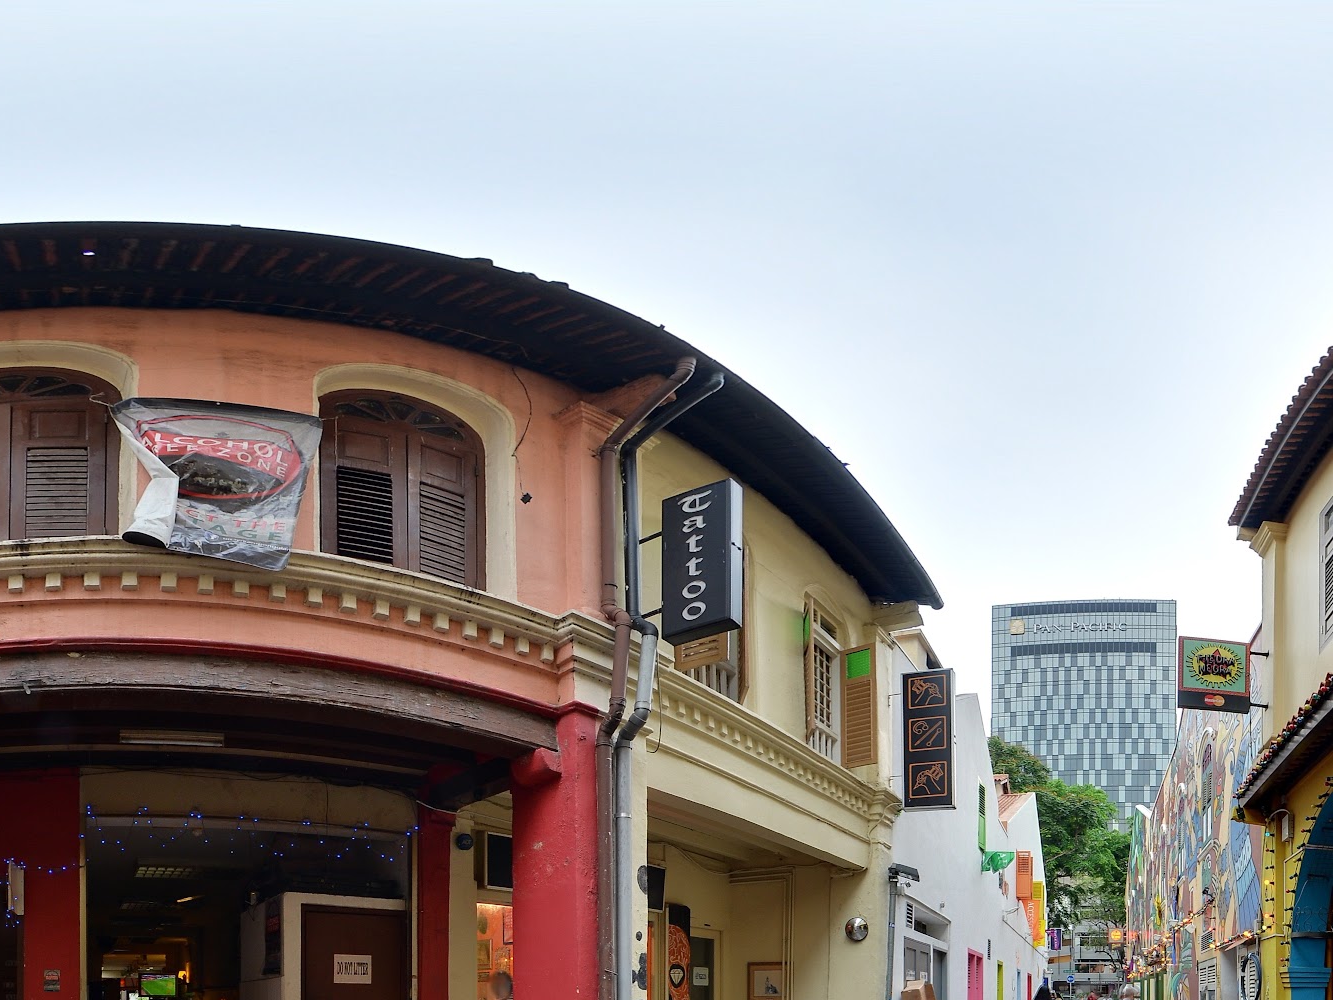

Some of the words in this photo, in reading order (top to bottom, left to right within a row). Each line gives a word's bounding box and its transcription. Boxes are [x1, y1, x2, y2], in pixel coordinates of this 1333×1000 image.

[217, 448, 287, 479] ZONE
[235, 518, 286, 532] THE
[677, 489, 712, 621] Tattoo
[1033, 624, 1063, 634] PAN
[1070, 622, 1128, 633] PACIFIC
[1196, 654, 1236, 666] PIEDRA
[1199, 664, 1233, 675] NEGRA
[337, 961, 344, 975] DO
[344, 961, 353, 975] NOT
[353, 962, 369, 976] LITTER
